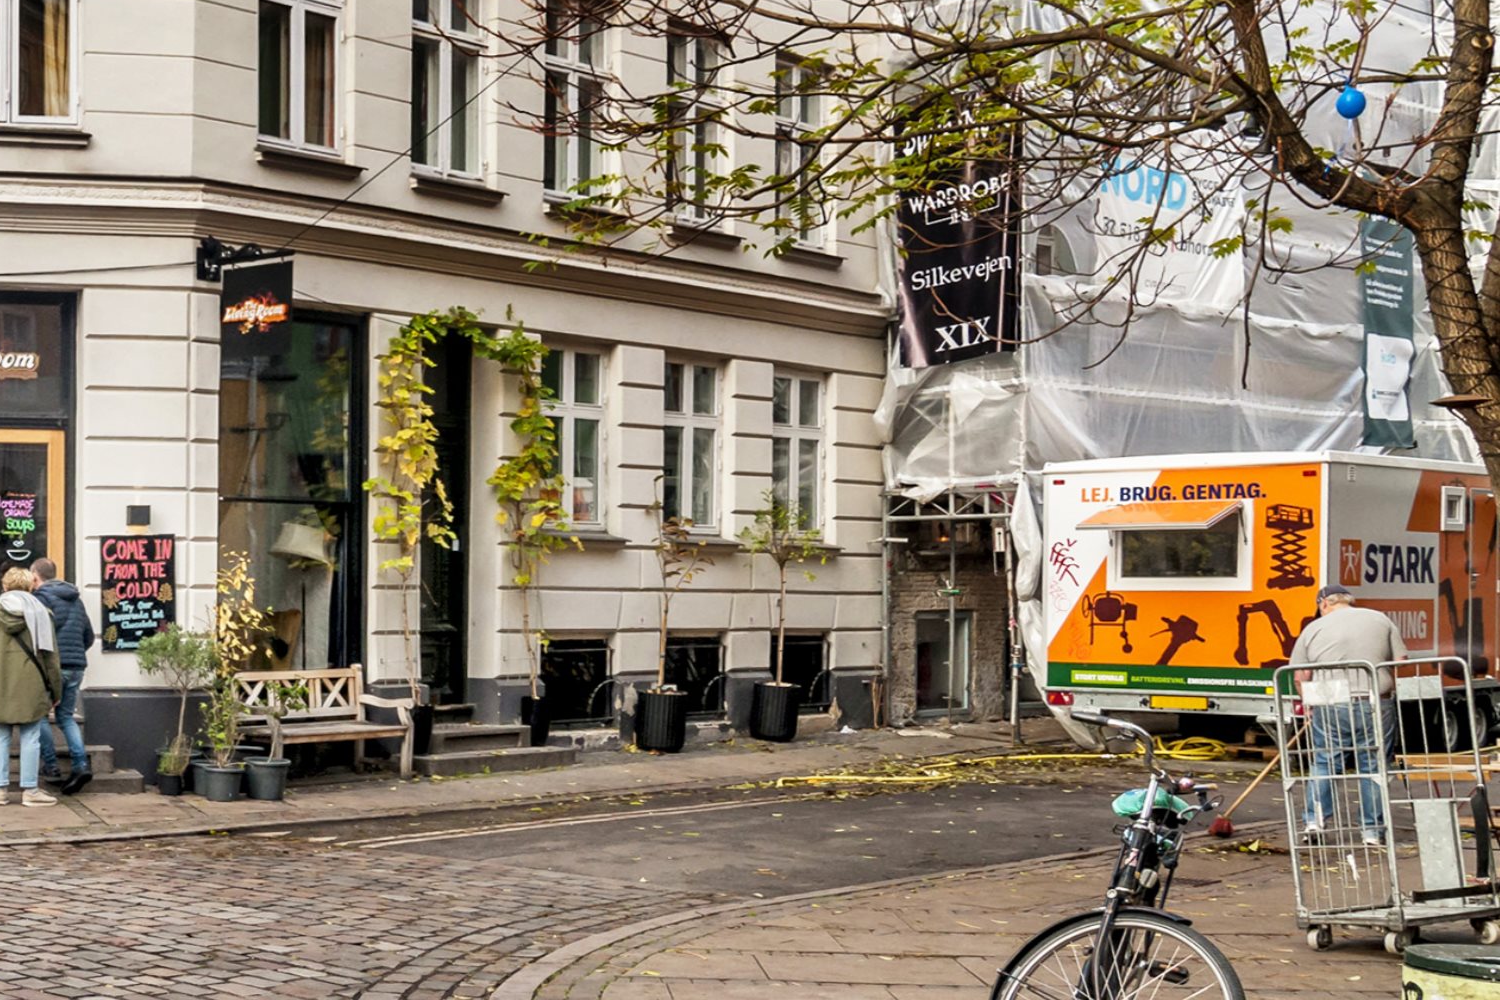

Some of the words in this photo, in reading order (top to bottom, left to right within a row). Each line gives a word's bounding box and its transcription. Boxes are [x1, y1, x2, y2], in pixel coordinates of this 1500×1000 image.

[908, 172, 1012, 214] WARDROBE
[1101, 157, 1187, 211] NORD
[911, 255, 1012, 291] Silkevejen
[934, 316, 991, 352] XIX
[1081, 487, 1114, 503] LEJ.
[1119, 485, 1177, 502] BRUG.
[1182, 482, 1267, 500] GENTAG.
[102, 539, 148, 561] COME
[154, 538, 173, 559] IN
[1364, 543, 1435, 584] STARK
[104, 563, 138, 579] FROM
[141, 562, 166, 578] THE
[116, 580, 159, 599] COLD!
